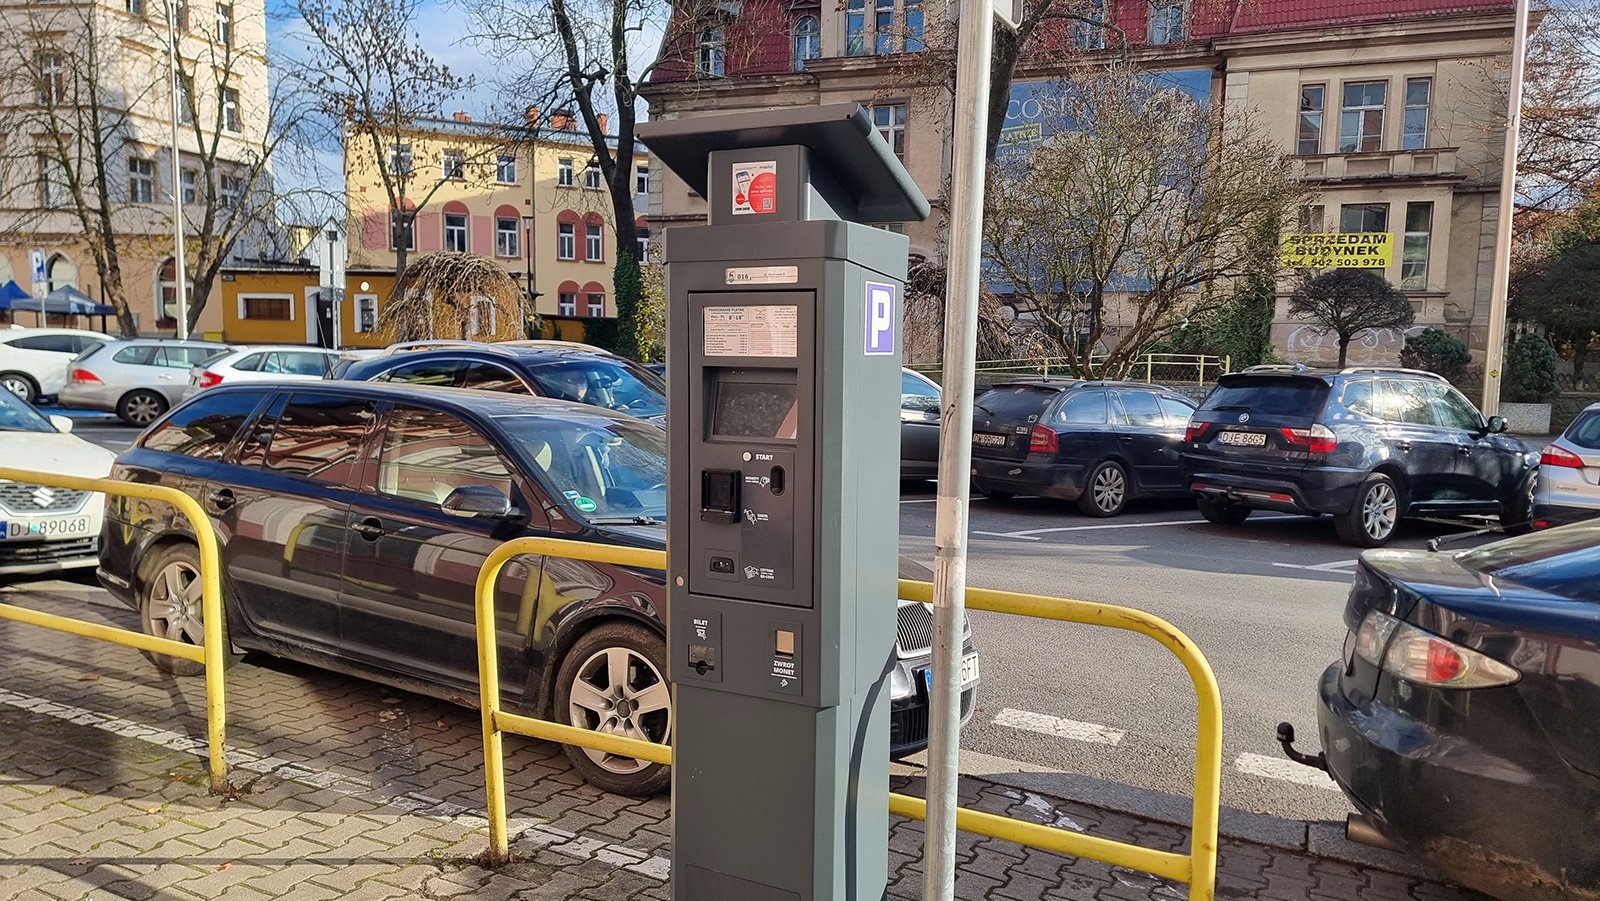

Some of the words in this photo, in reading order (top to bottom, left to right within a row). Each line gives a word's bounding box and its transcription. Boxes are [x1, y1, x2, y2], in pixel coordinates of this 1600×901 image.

[1290, 234, 1387, 245] SPRZEDAM
[1295, 246, 1380, 256] BUDYNEK
[871, 289, 891, 348] P
[1222, 432, 1241, 442] DJE
[10, 522, 31, 537] DJ
[39, 519, 86, 534] 89068
[693, 618, 709, 626] BILET
[773, 660, 795, 669] ZWROT
[773, 667, 795, 676] MONET
